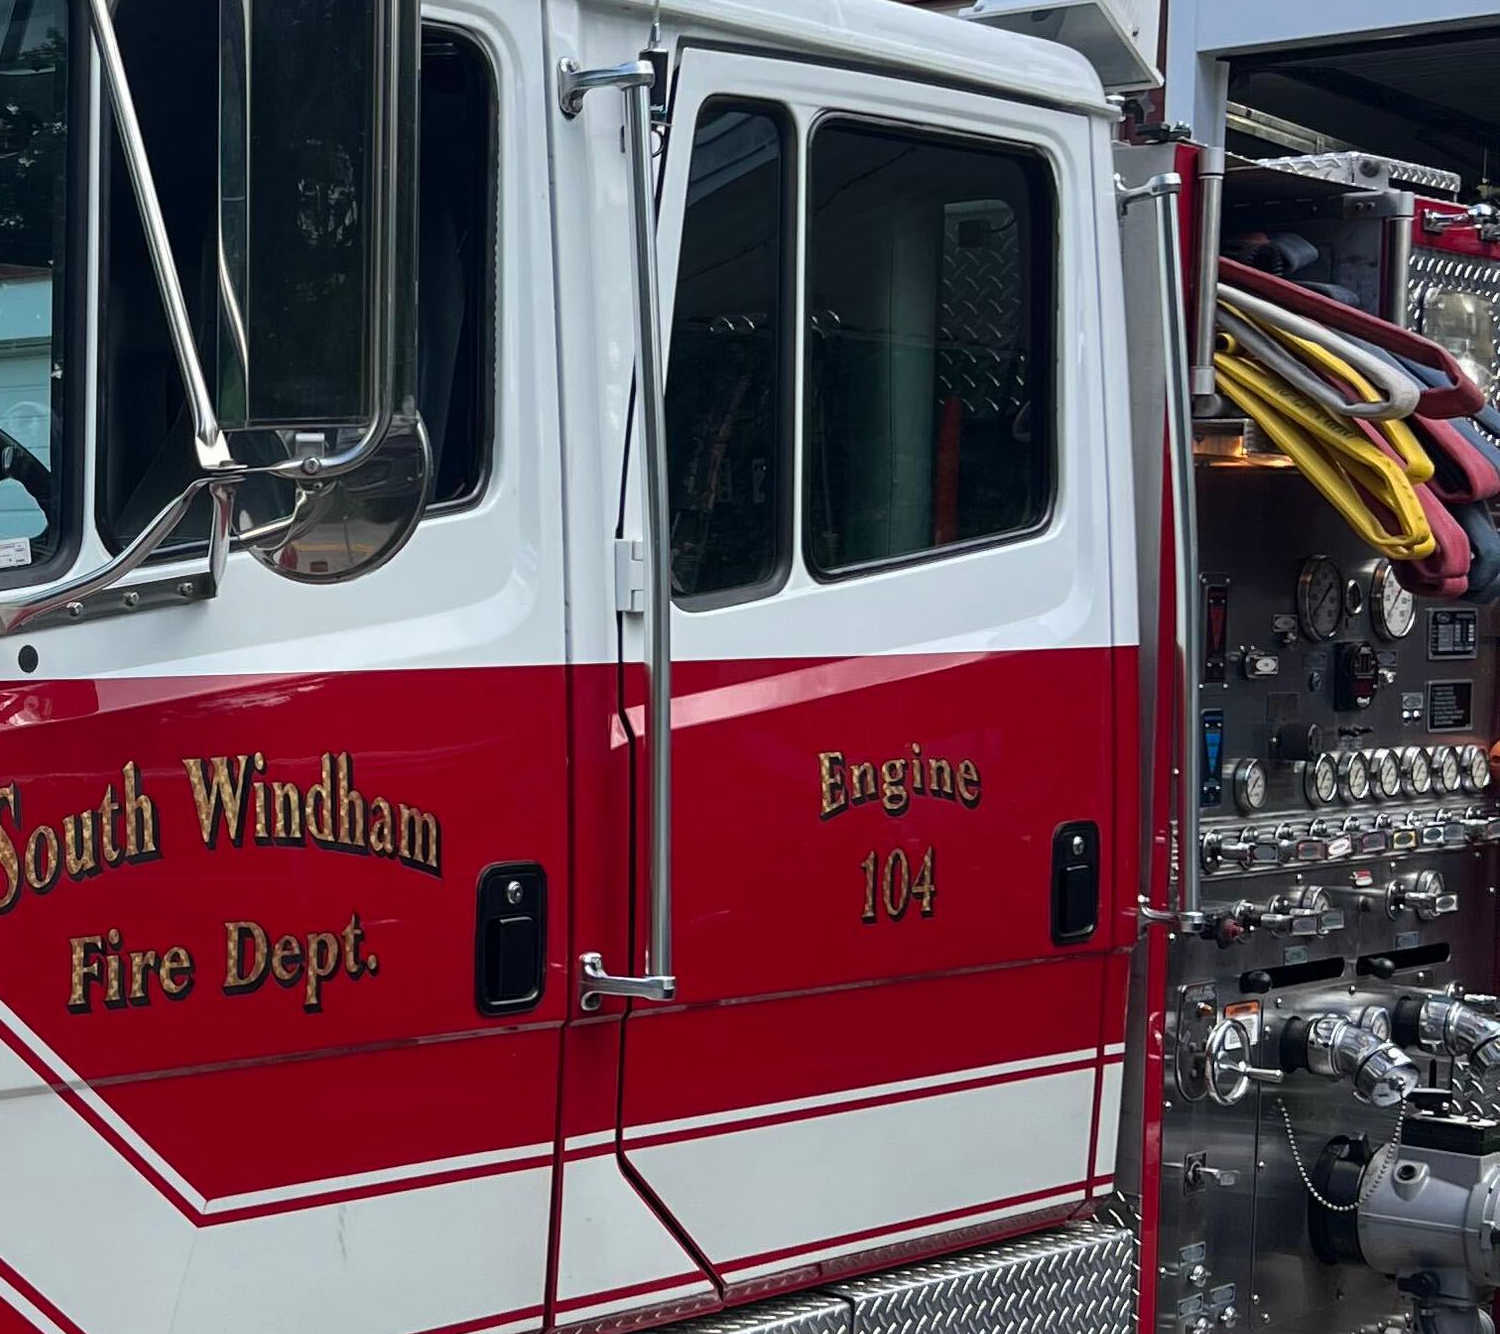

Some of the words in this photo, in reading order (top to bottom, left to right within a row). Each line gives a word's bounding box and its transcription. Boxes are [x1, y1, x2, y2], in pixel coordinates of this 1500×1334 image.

[181, 751, 443, 878] Windham
[817, 742, 982, 822] Engine
[860, 845, 937, 925] 104
[66, 928, 196, 1014] Fire
[222, 913, 380, 1014] Dept.
